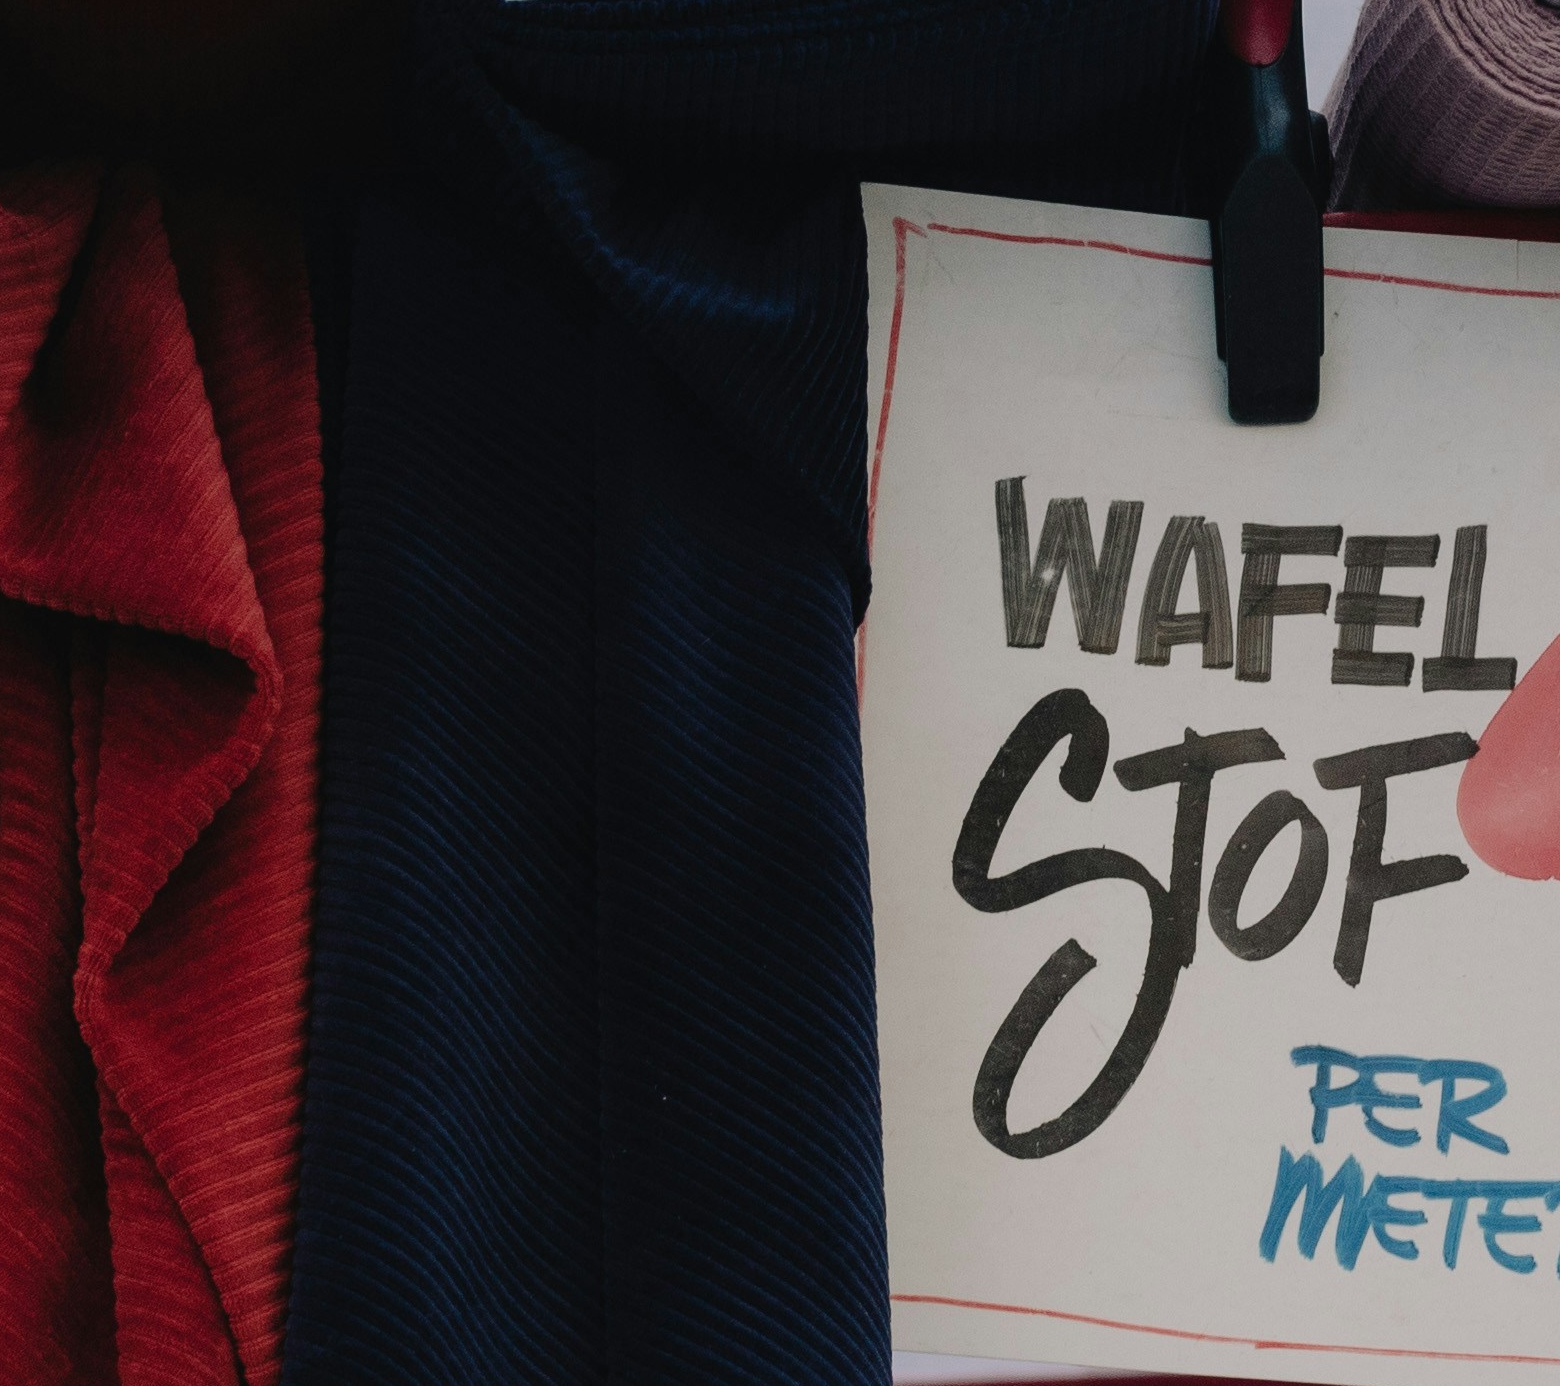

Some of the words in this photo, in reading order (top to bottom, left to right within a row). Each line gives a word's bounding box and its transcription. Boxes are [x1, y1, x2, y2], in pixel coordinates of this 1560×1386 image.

[994, 474, 1518, 693] WAFEL
[951, 687, 1481, 1161] STOF
[1290, 1043, 1510, 1156] PER
